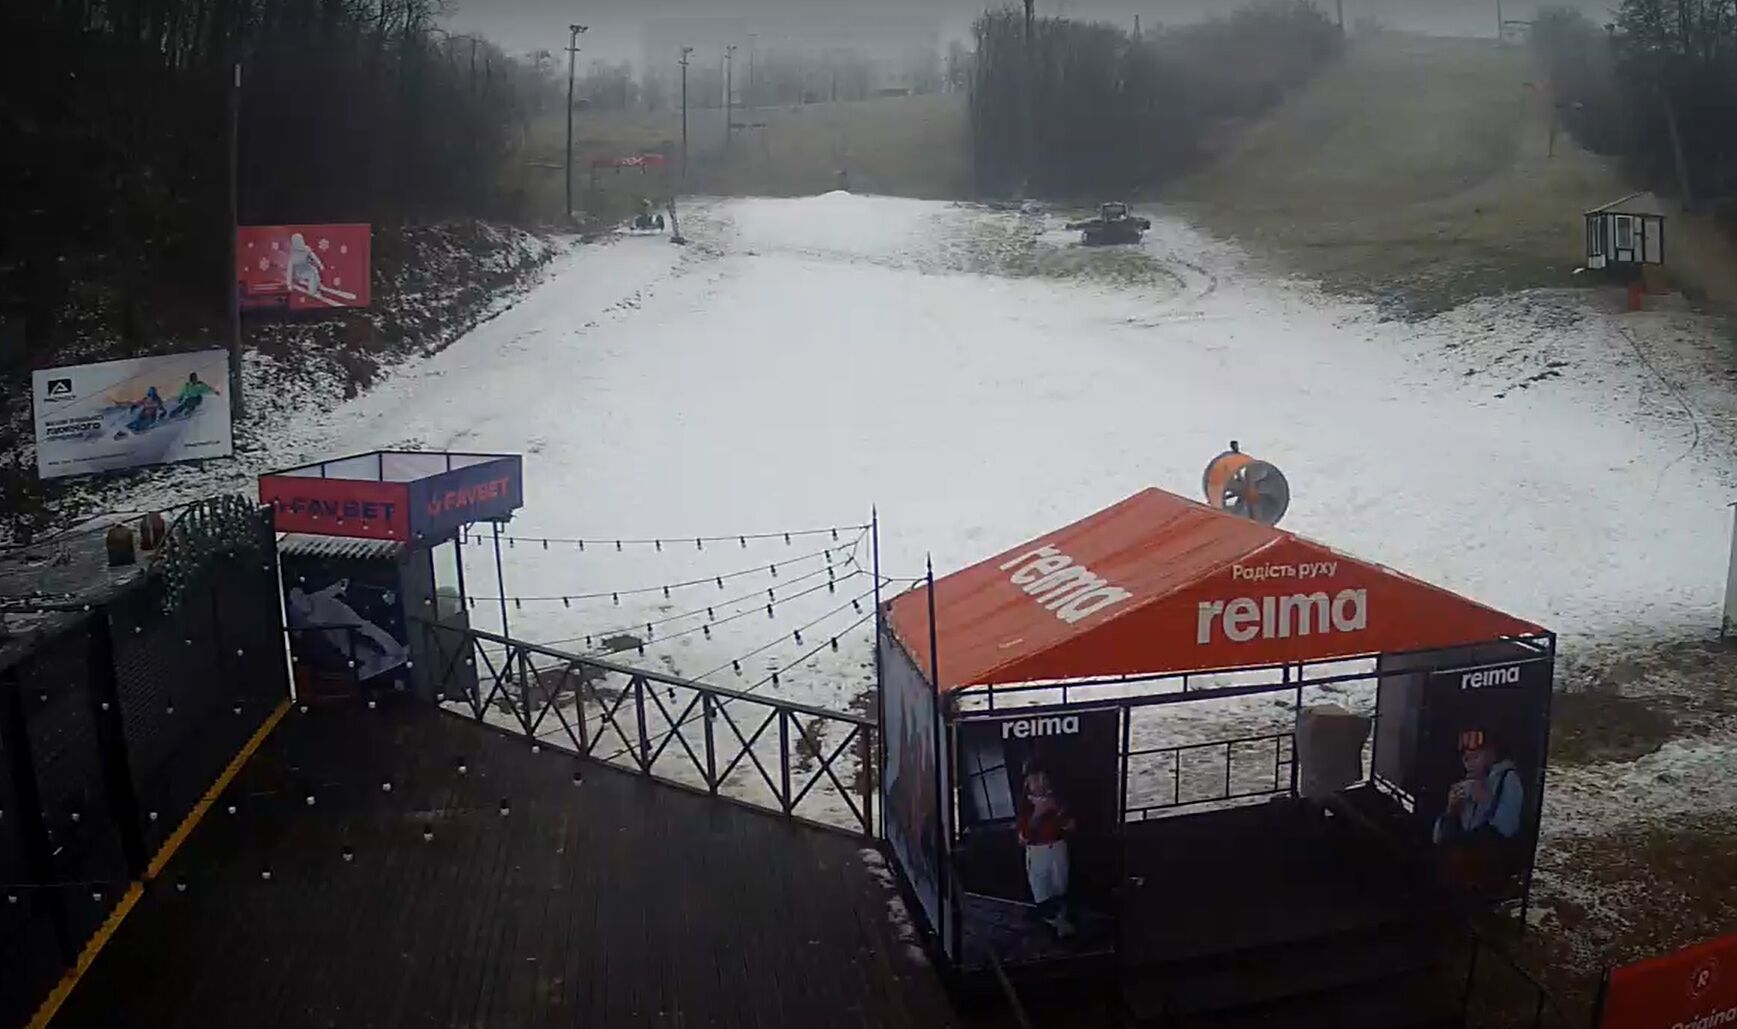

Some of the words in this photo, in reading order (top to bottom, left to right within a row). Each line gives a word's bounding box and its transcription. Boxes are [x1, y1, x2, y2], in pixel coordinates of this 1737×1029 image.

[443, 476, 510, 511] FAVBET
[292, 497, 395, 521] FAVBET
[1232, 563, 1296, 582] Радість
[1299, 560, 1338, 581] руху
[999, 543, 1134, 625] reima
[1196, 588, 1368, 646] reima
[1461, 665, 1520, 690] reima
[1002, 714, 1080, 739] reima
